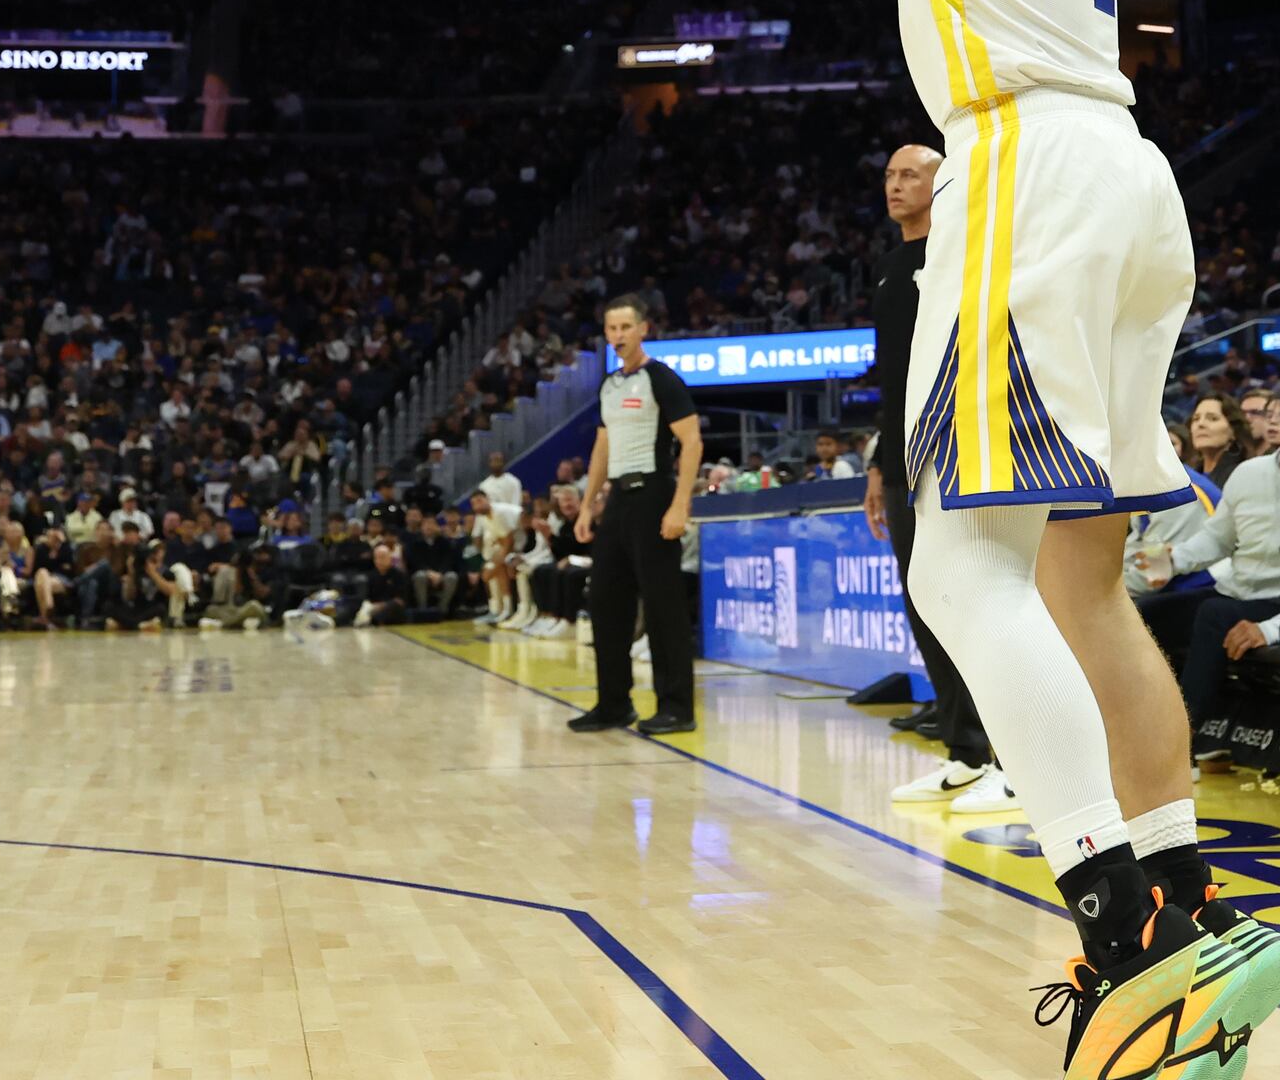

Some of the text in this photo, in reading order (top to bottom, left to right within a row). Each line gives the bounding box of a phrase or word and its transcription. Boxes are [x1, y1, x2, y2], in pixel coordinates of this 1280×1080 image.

[60, 50, 148, 70] RESORT
[749, 343, 876, 369] AIRLINES
[724, 555, 773, 590] UNITED
[715, 598, 774, 637] AIRLINES
[822, 608, 905, 654] AIRLINES
